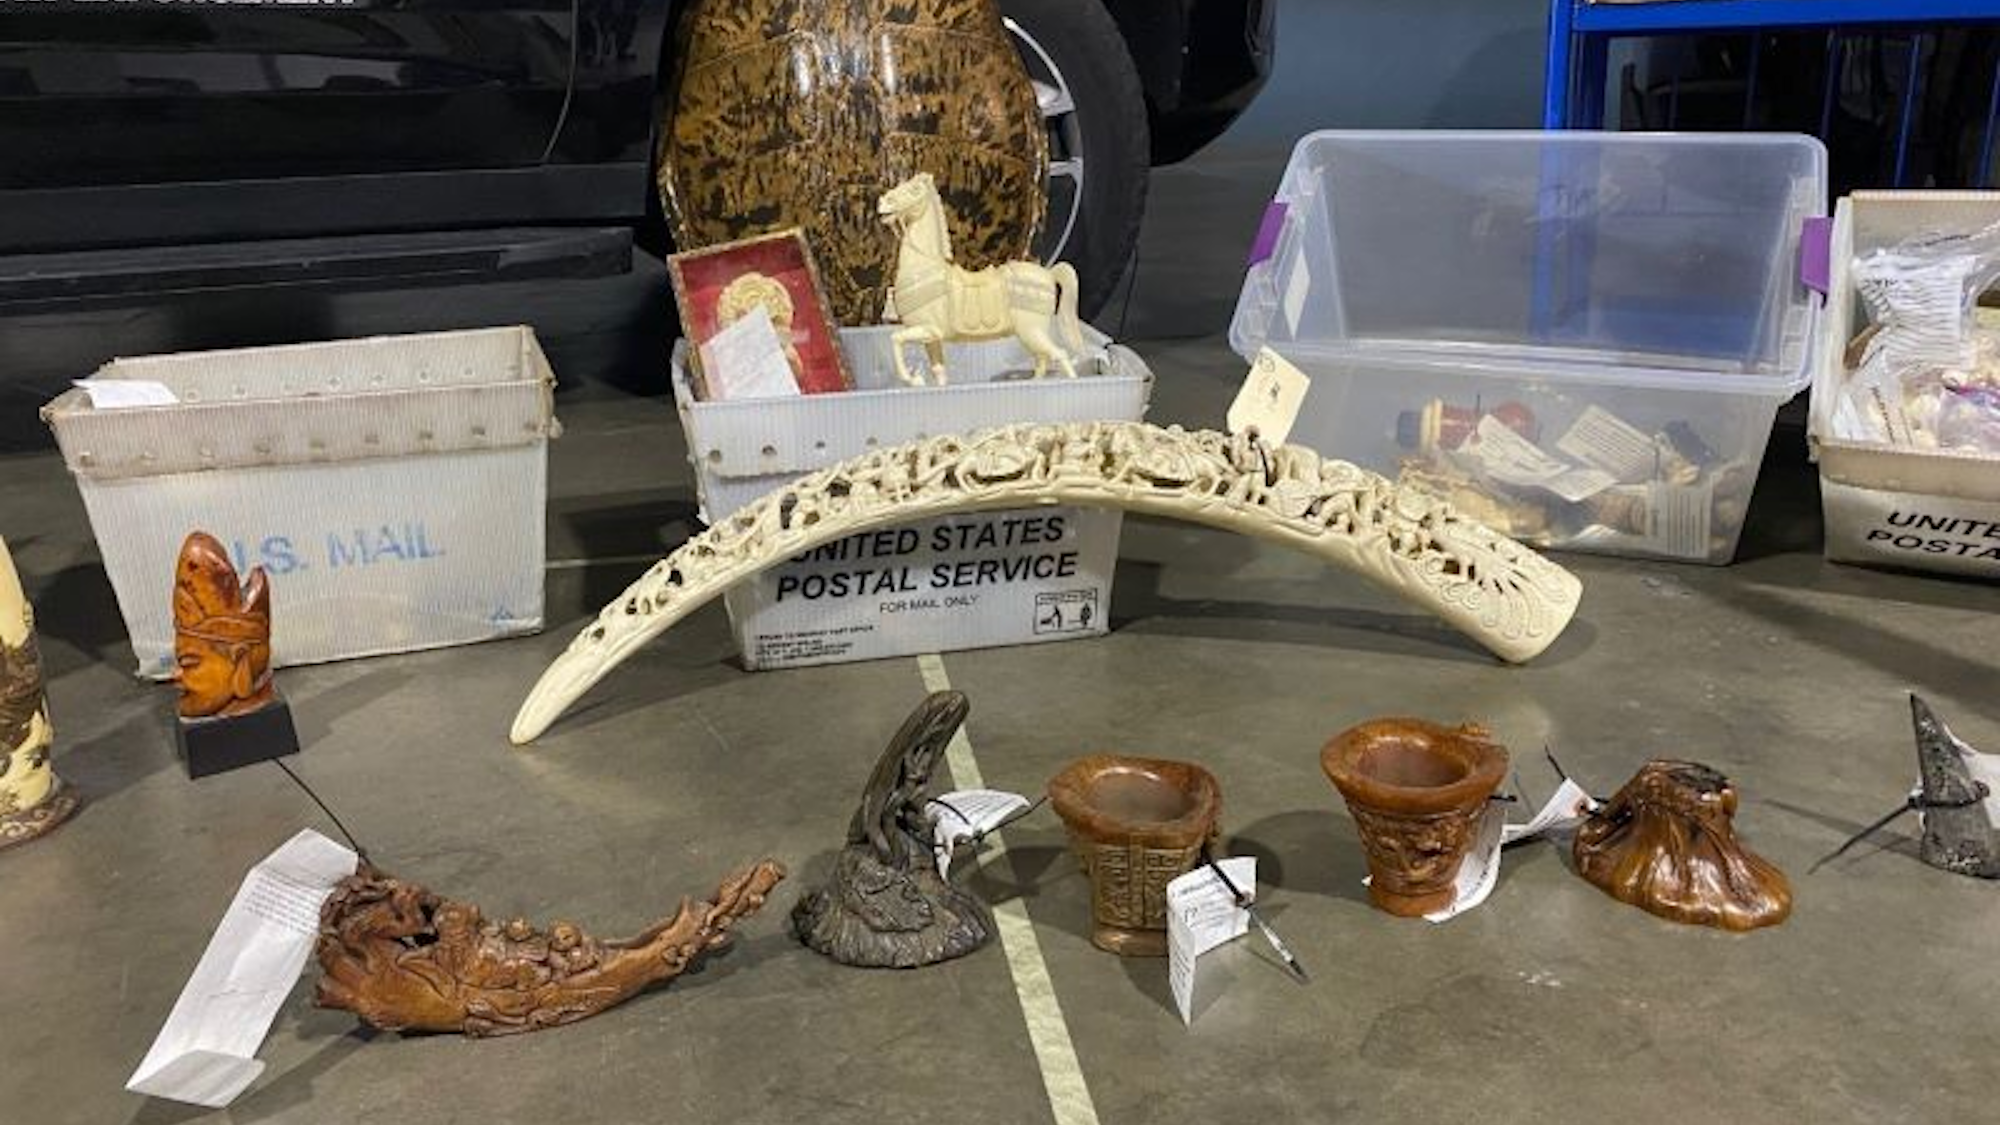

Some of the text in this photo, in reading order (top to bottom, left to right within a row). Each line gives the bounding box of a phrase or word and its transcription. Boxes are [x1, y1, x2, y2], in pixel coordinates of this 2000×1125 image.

[931, 516, 1064, 552] STATES
[1887, 511, 2000, 539] UNITE
[326, 520, 446, 568] MAIL
[1867, 529, 2000, 559] POSTA
[777, 551, 1078, 602] POSTAL SERVICE
[880, 594, 981, 614] FOR MAIL ONLY
